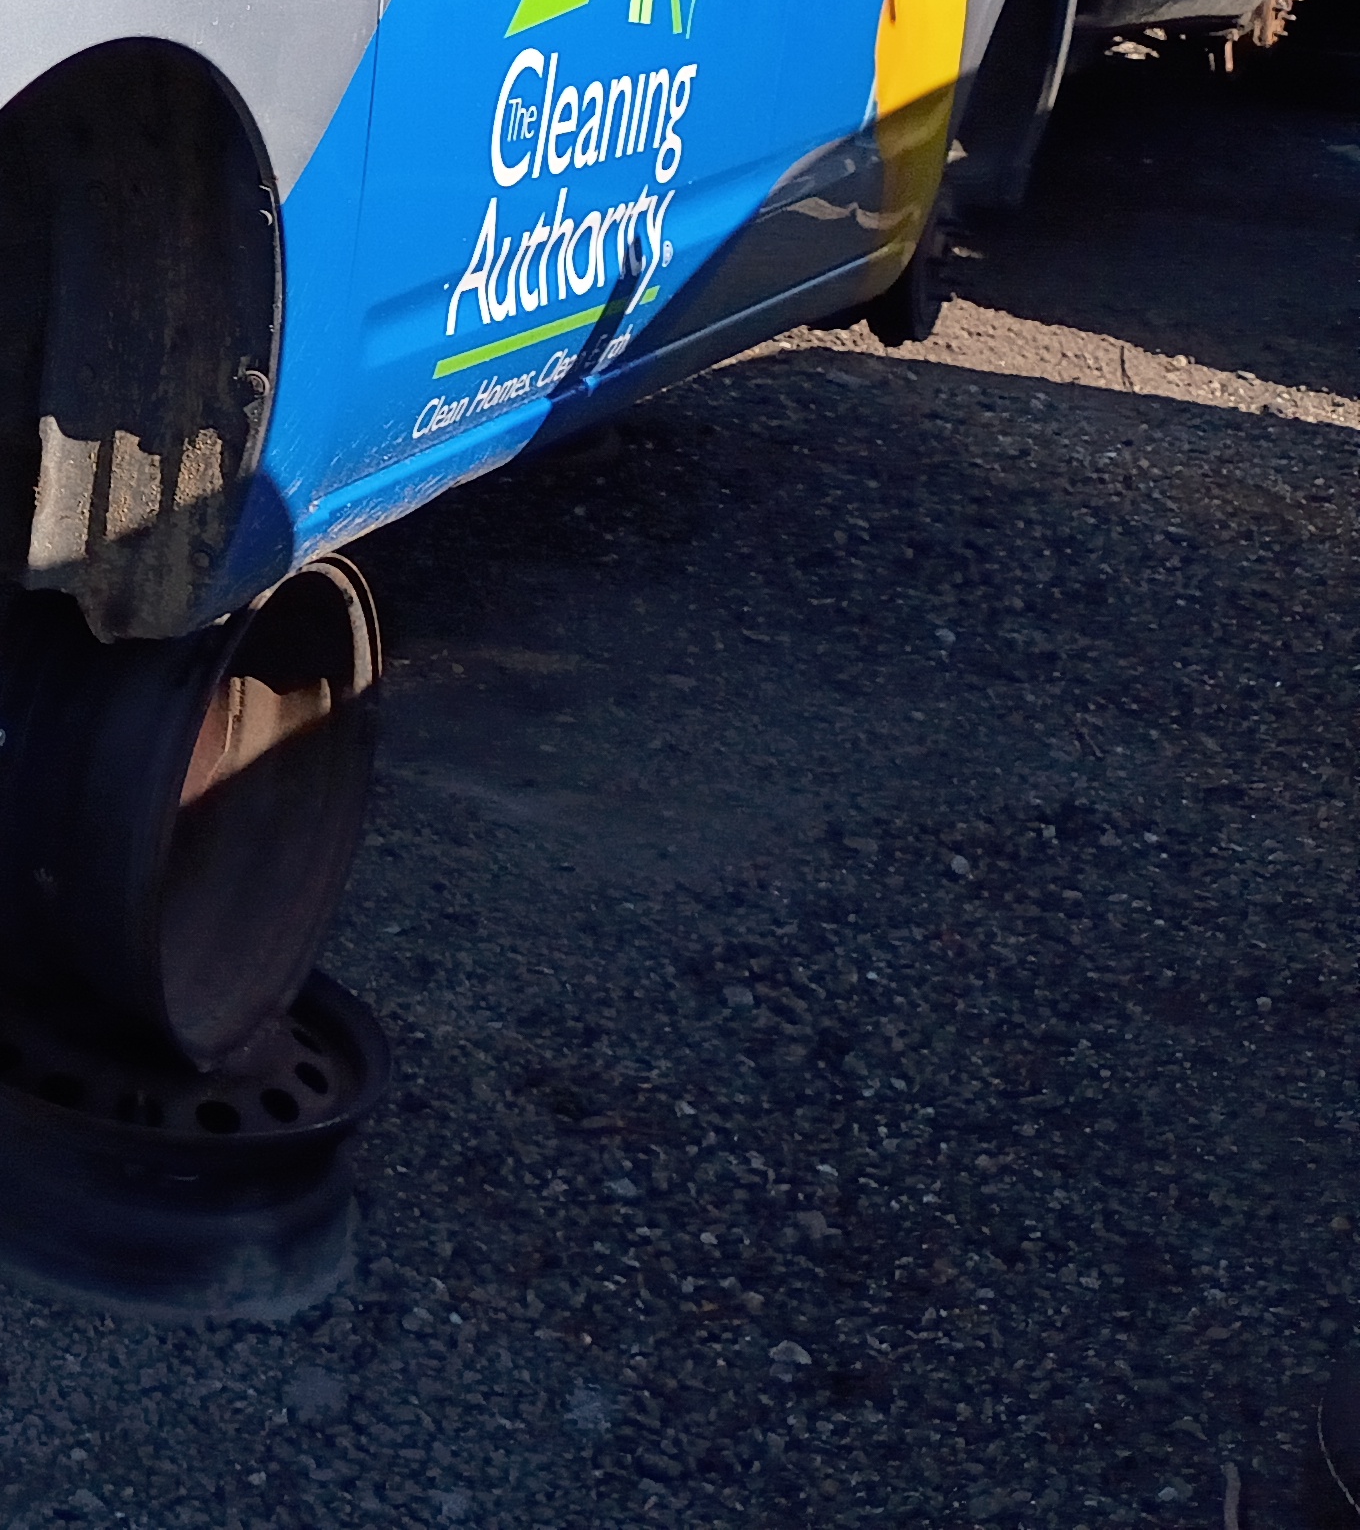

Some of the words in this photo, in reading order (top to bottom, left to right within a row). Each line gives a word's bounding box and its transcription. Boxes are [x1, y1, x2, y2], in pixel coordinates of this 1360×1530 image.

[491, 47, 698, 187] Cleaning
[506, 97, 538, 142] The
[445, 184, 676, 336] Authority
[411, 395, 470, 439] Clean
